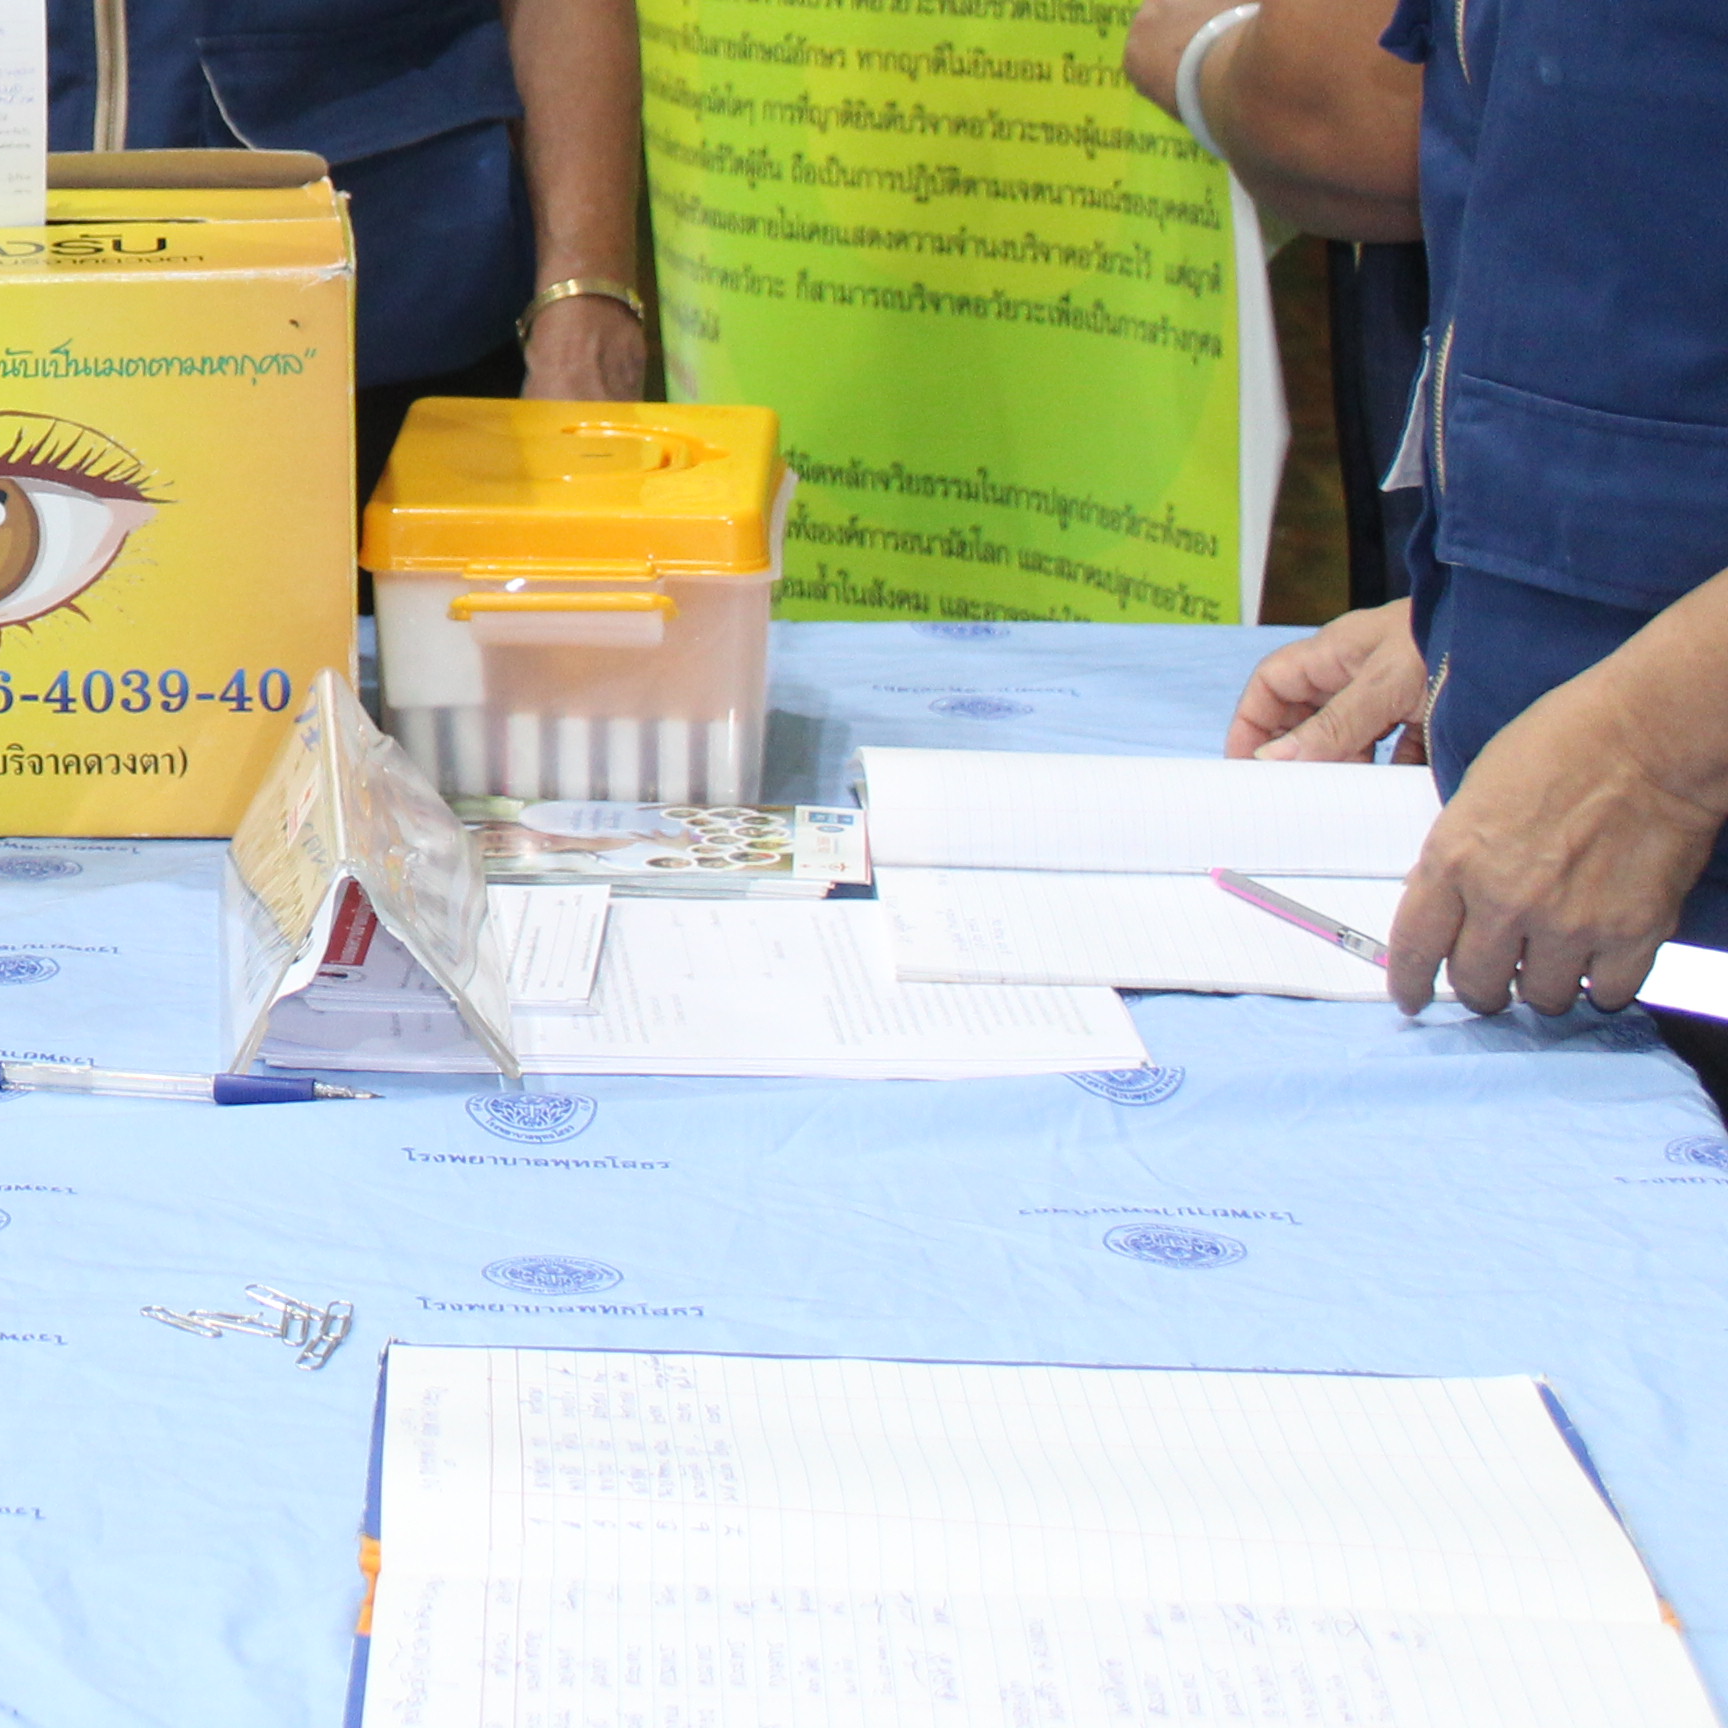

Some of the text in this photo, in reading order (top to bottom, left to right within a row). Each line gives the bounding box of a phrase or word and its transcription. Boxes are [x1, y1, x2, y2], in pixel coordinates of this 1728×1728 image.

[400, 1146, 672, 1171] โรงพยาบาลพุทธโสธร
